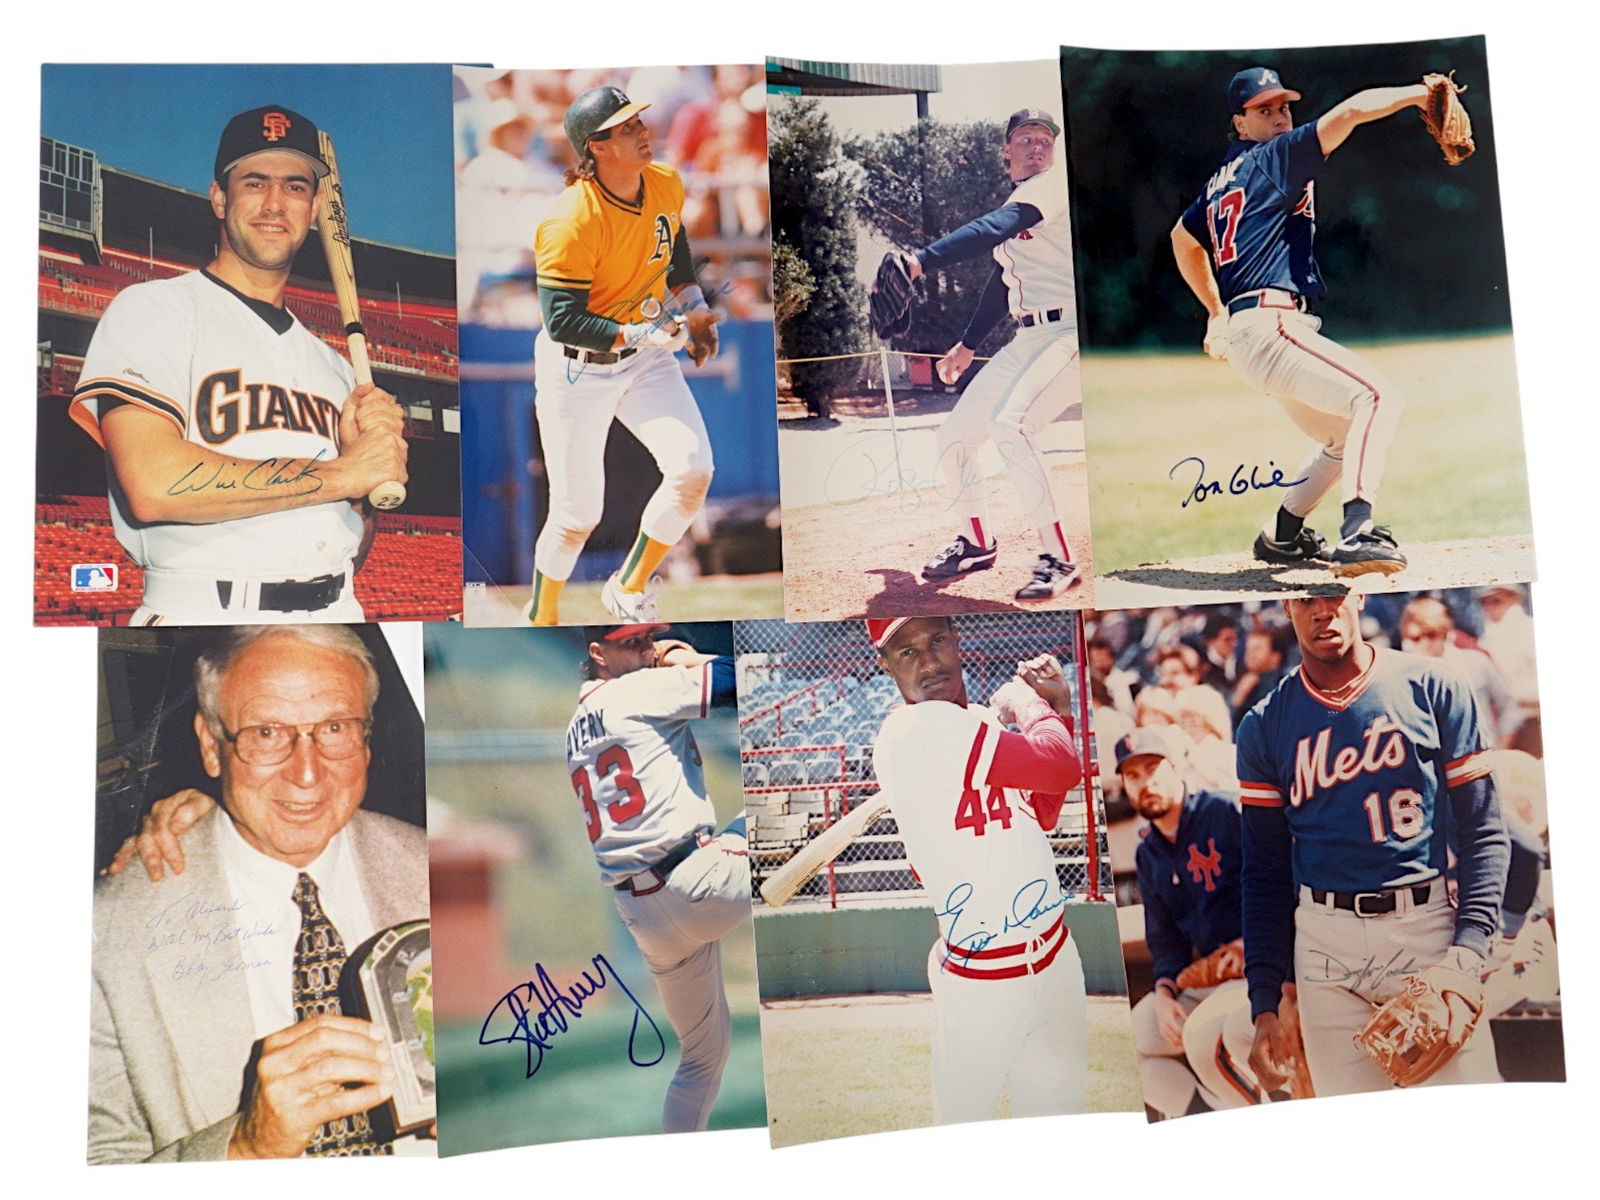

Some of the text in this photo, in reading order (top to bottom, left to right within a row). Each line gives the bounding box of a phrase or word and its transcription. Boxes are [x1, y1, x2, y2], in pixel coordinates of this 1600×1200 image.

[377, 496, 400, 506] 22
[1289, 713, 1407, 808] Mets
[570, 743, 647, 844] 33
[954, 786, 1013, 837] 44
[1362, 786, 1424, 844] 16
